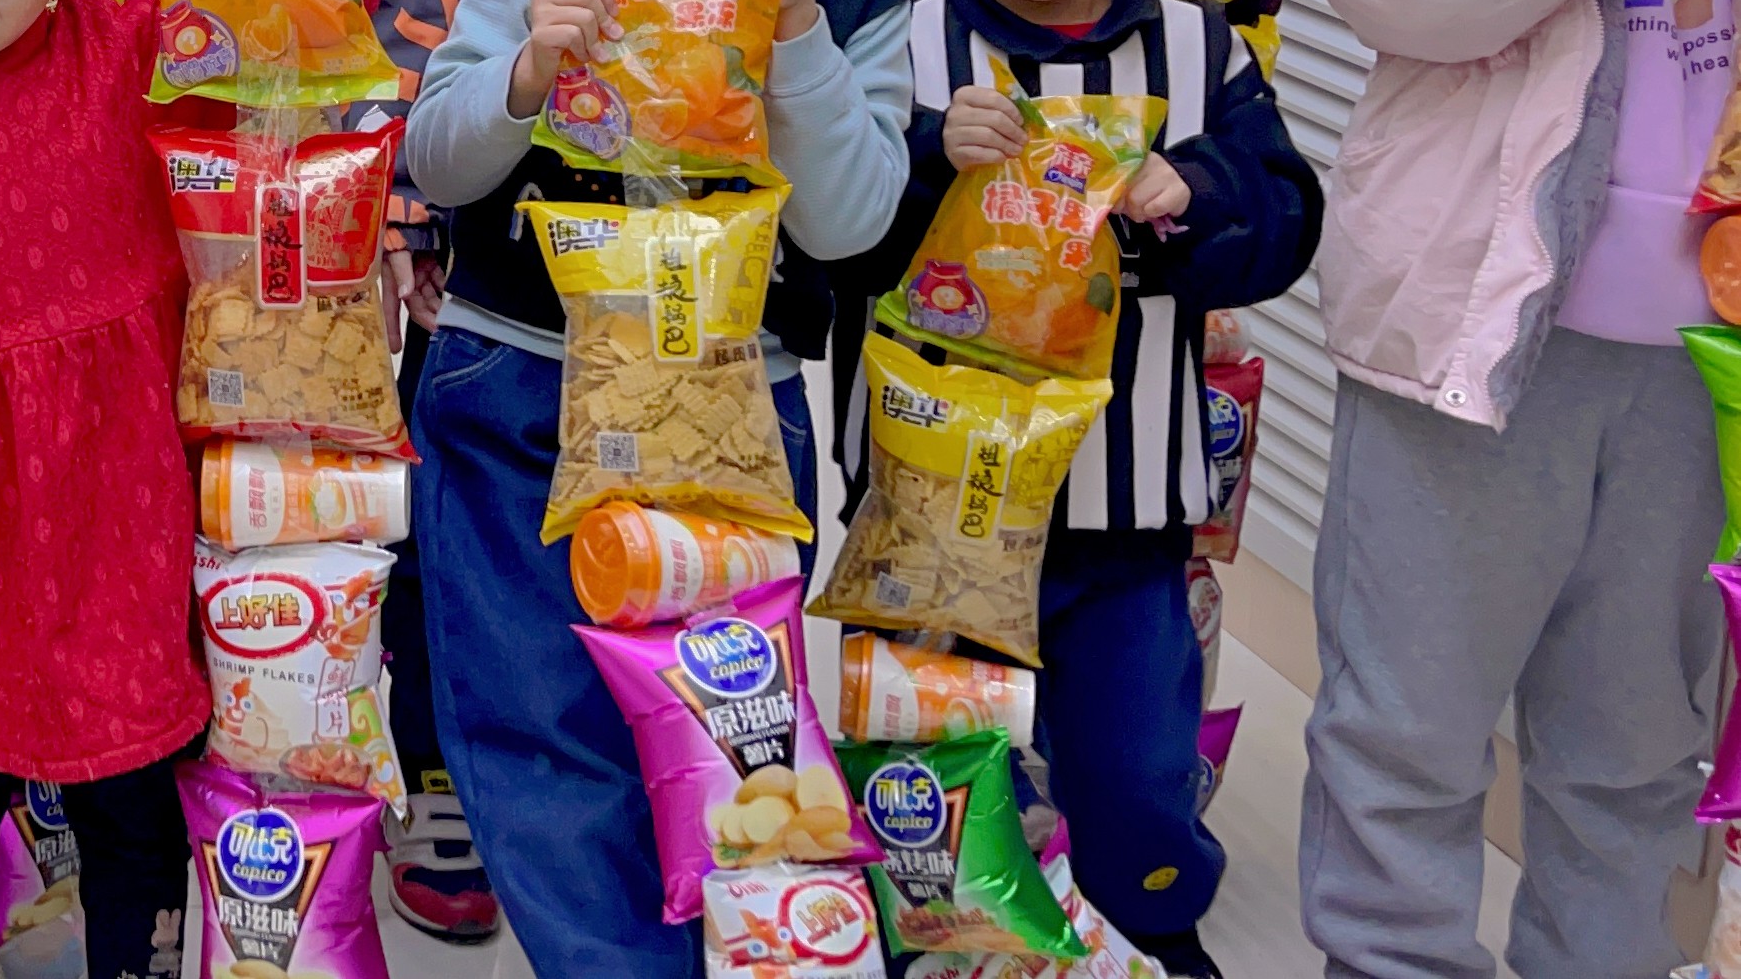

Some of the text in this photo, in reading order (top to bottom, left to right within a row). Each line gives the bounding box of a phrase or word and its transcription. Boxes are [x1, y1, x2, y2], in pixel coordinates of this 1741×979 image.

[215, 592, 301, 629] 上好佳
[689, 624, 762, 663] 可比克
[213, 657, 315, 684] SHRIMP FLAKES
[705, 693, 796, 740] 原滋味
[741, 739, 784, 766] 薯片
[874, 776, 936, 817] 可比克
[231, 822, 293, 865] 可比克
[219, 896, 299, 937] 原滋味
